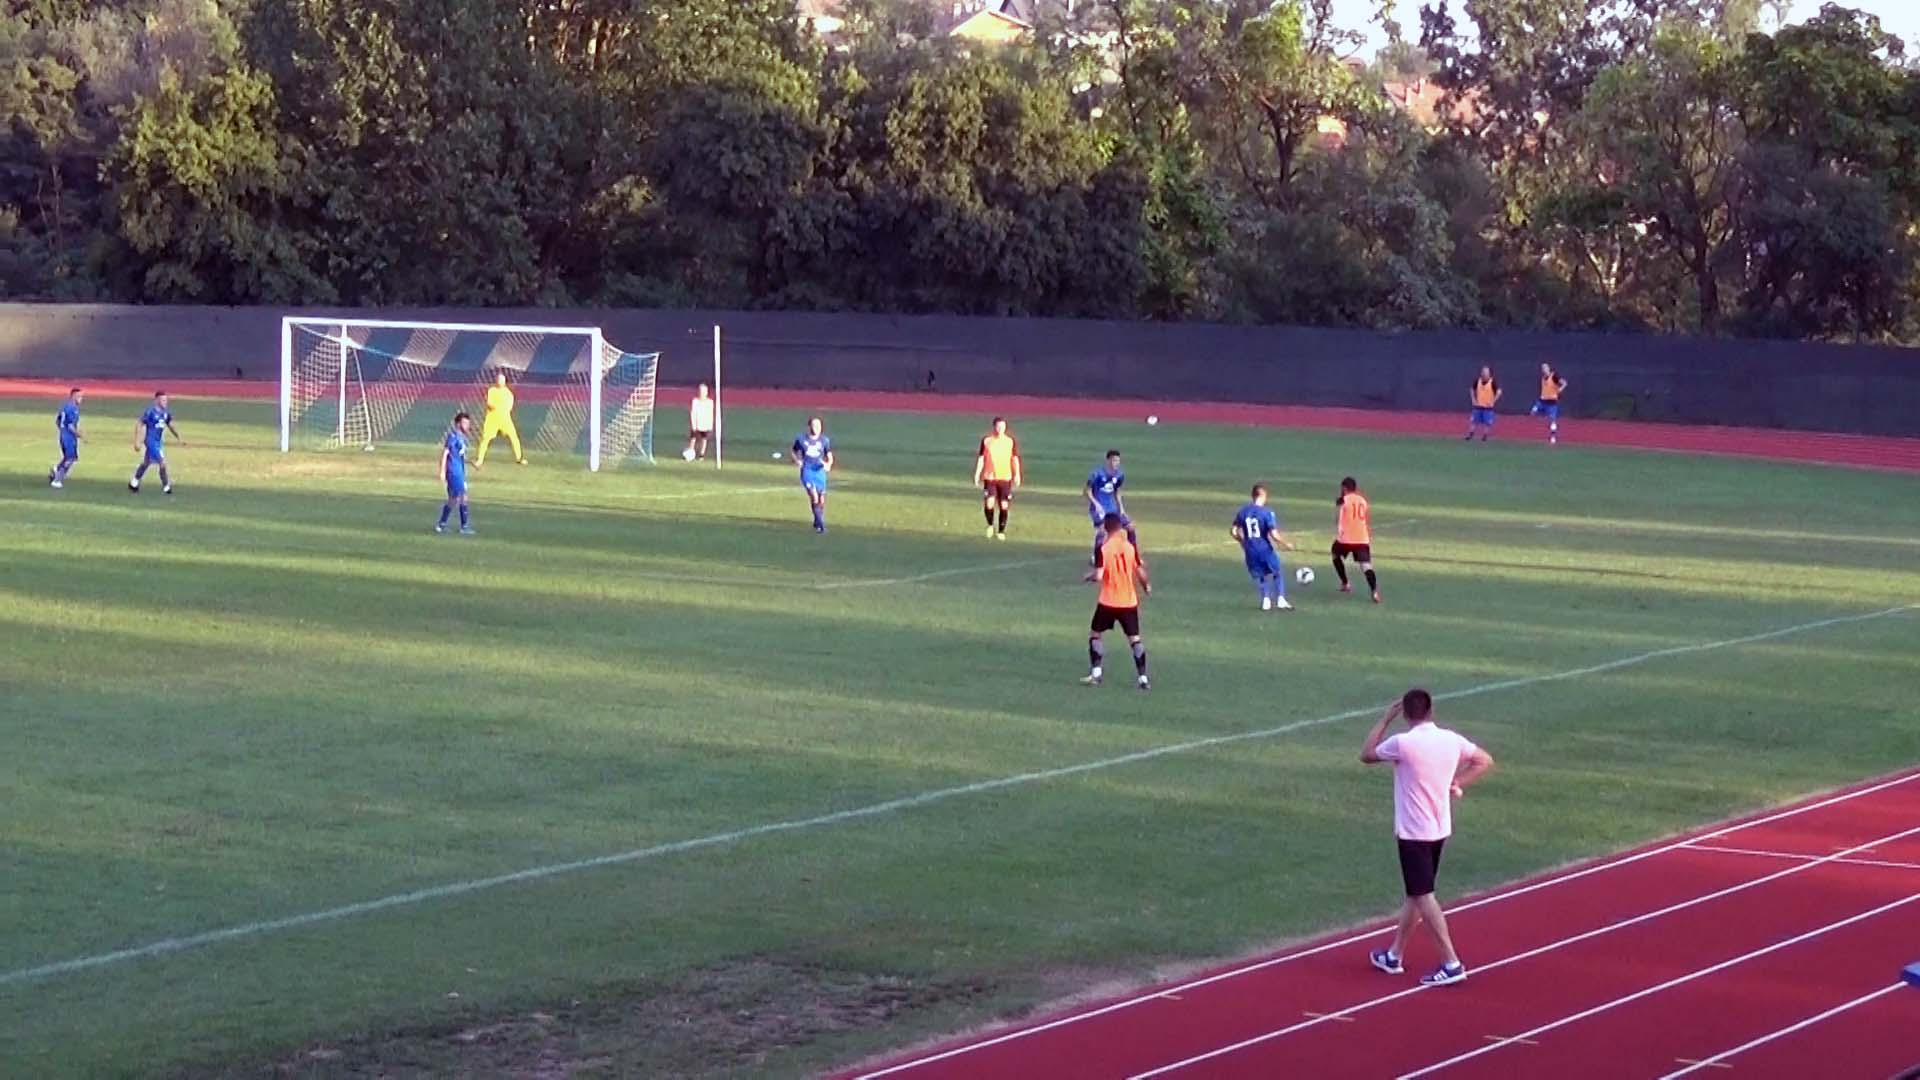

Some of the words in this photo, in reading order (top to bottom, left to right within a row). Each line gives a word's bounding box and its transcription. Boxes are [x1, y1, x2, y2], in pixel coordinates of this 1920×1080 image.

[1352, 503, 1366, 520] 10
[1245, 516, 1261, 538] 13
[1114, 551, 1127, 574] 11
